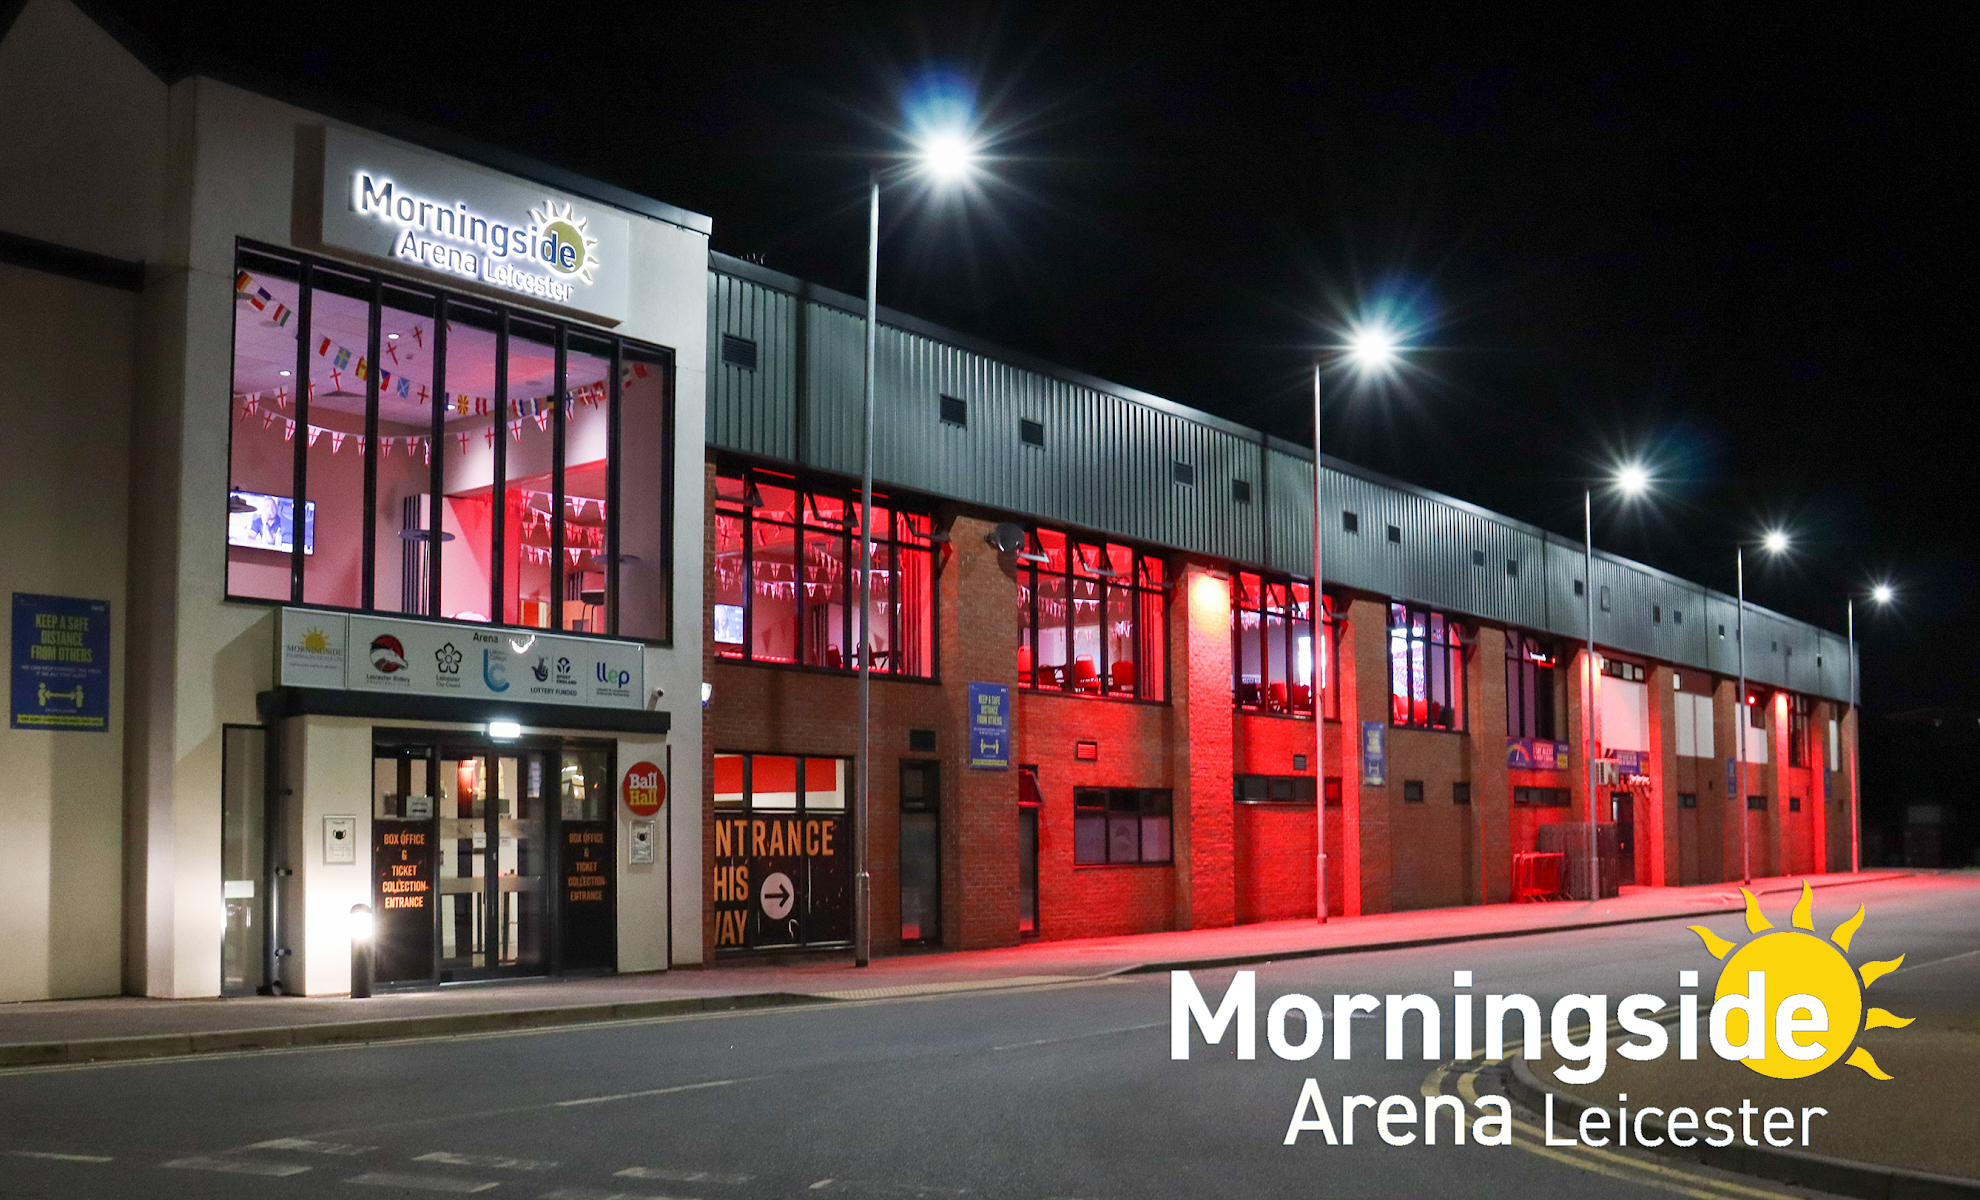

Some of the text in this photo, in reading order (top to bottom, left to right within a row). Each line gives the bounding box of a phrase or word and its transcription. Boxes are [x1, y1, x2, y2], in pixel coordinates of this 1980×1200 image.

[361, 174, 576, 268] Morningside
[400, 230, 574, 301] Arena Leicester
[35, 613, 89, 631] KEEP A SAFE
[41, 629, 83, 646] DISTANCE
[473, 632, 498, 643] Arena
[31, 645, 93, 663] FROM OTHERS
[596, 662, 630, 688] llep
[530, 687, 577, 696] LOTTERY FUNDED
[629, 771, 657, 789] Ball
[629, 788, 658, 805] Hall
[384, 833, 425, 845] BOX OFFICE
[568, 833, 604, 843] BOX OFFICE
[715, 819, 834, 857] NTRANCE
[391, 865, 417, 876] TICKET
[576, 862, 597, 872] TICKET
[382, 881, 427, 893] COLLECTION
[568, 876, 605, 887] COLLECTION
[714, 865, 749, 902] HIS
[385, 896, 424, 909] ENTRANCE
[570, 891, 603, 901] ENTRANCE
[714, 910, 748, 945] AY
